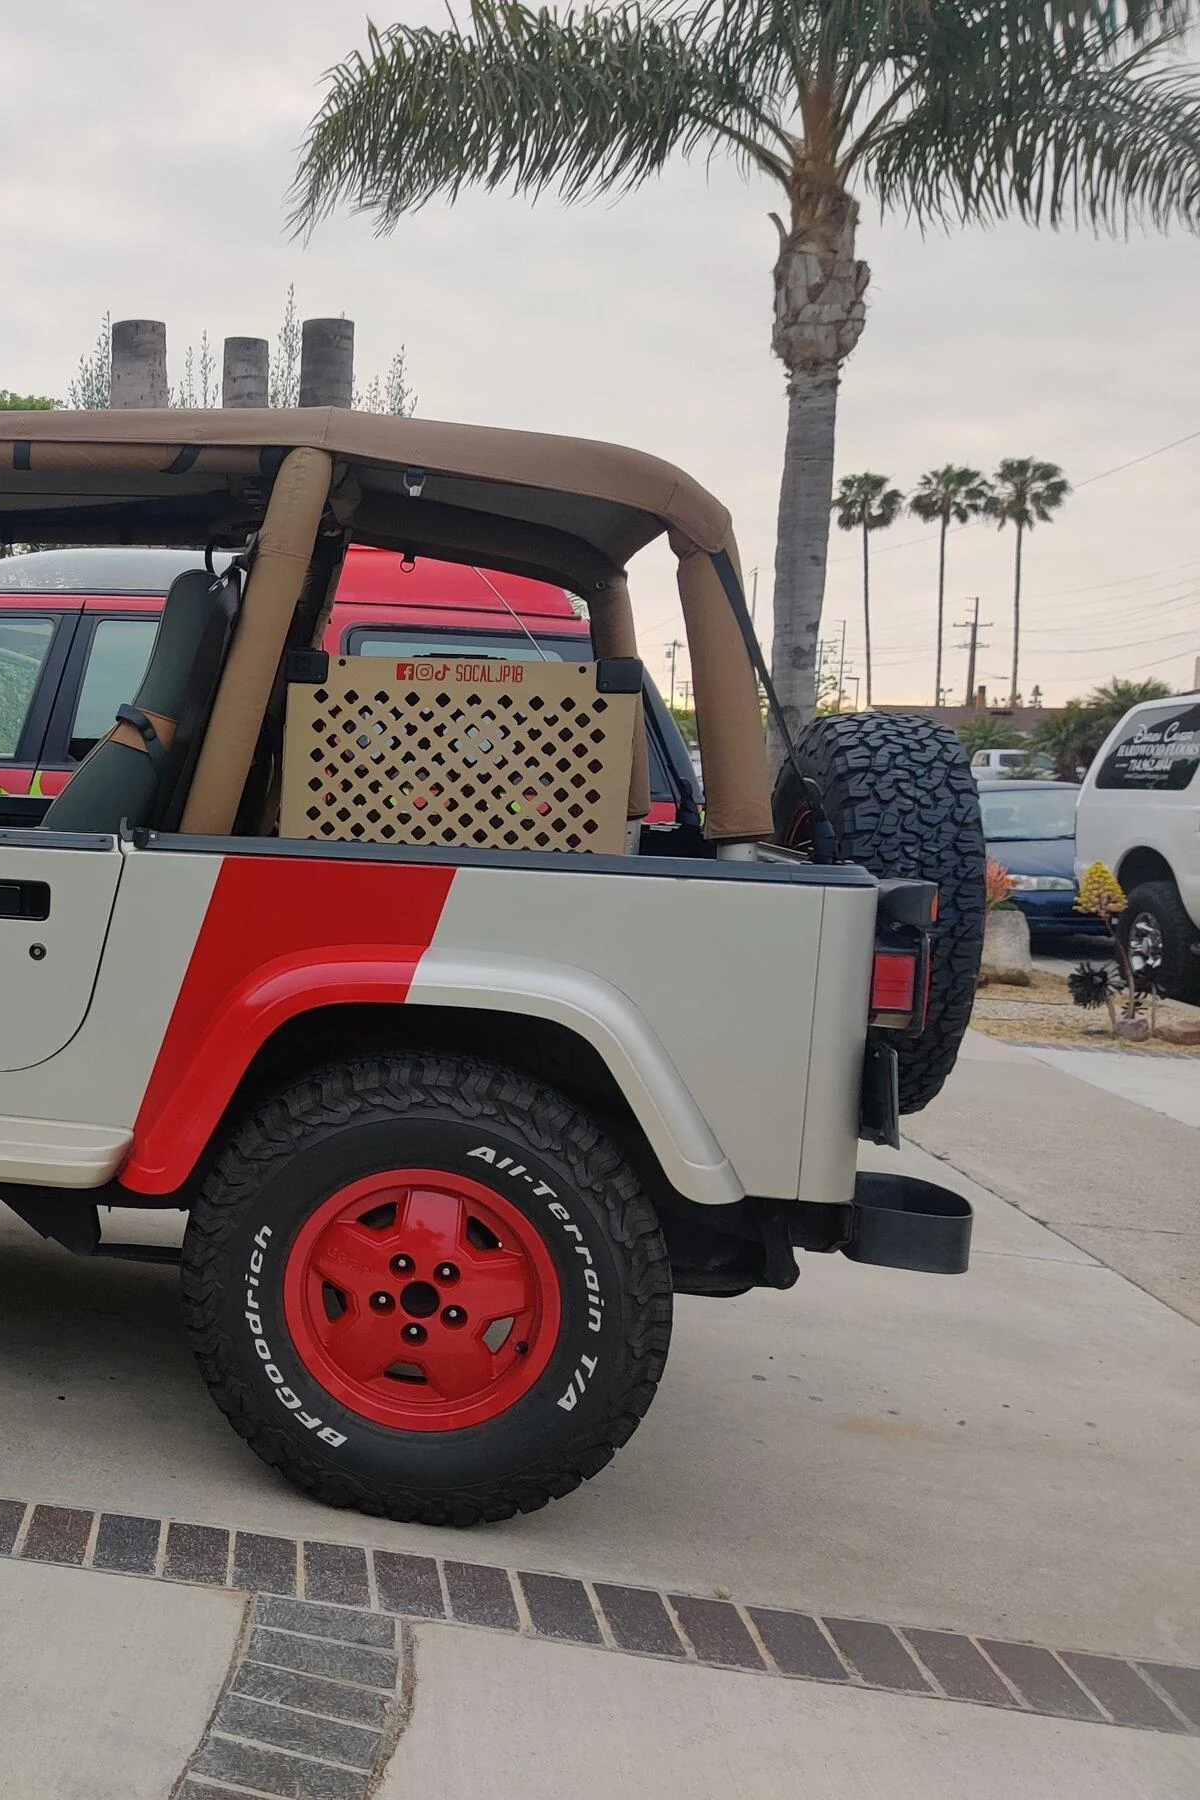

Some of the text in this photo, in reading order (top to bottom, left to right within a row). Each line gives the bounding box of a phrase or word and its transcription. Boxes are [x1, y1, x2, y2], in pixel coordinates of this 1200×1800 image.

[455, 664, 524, 683] SOCALJP18
[244, 1224, 348, 1449] BFGoodrich
[466, 1145, 605, 1412] All-Terrain T/A
